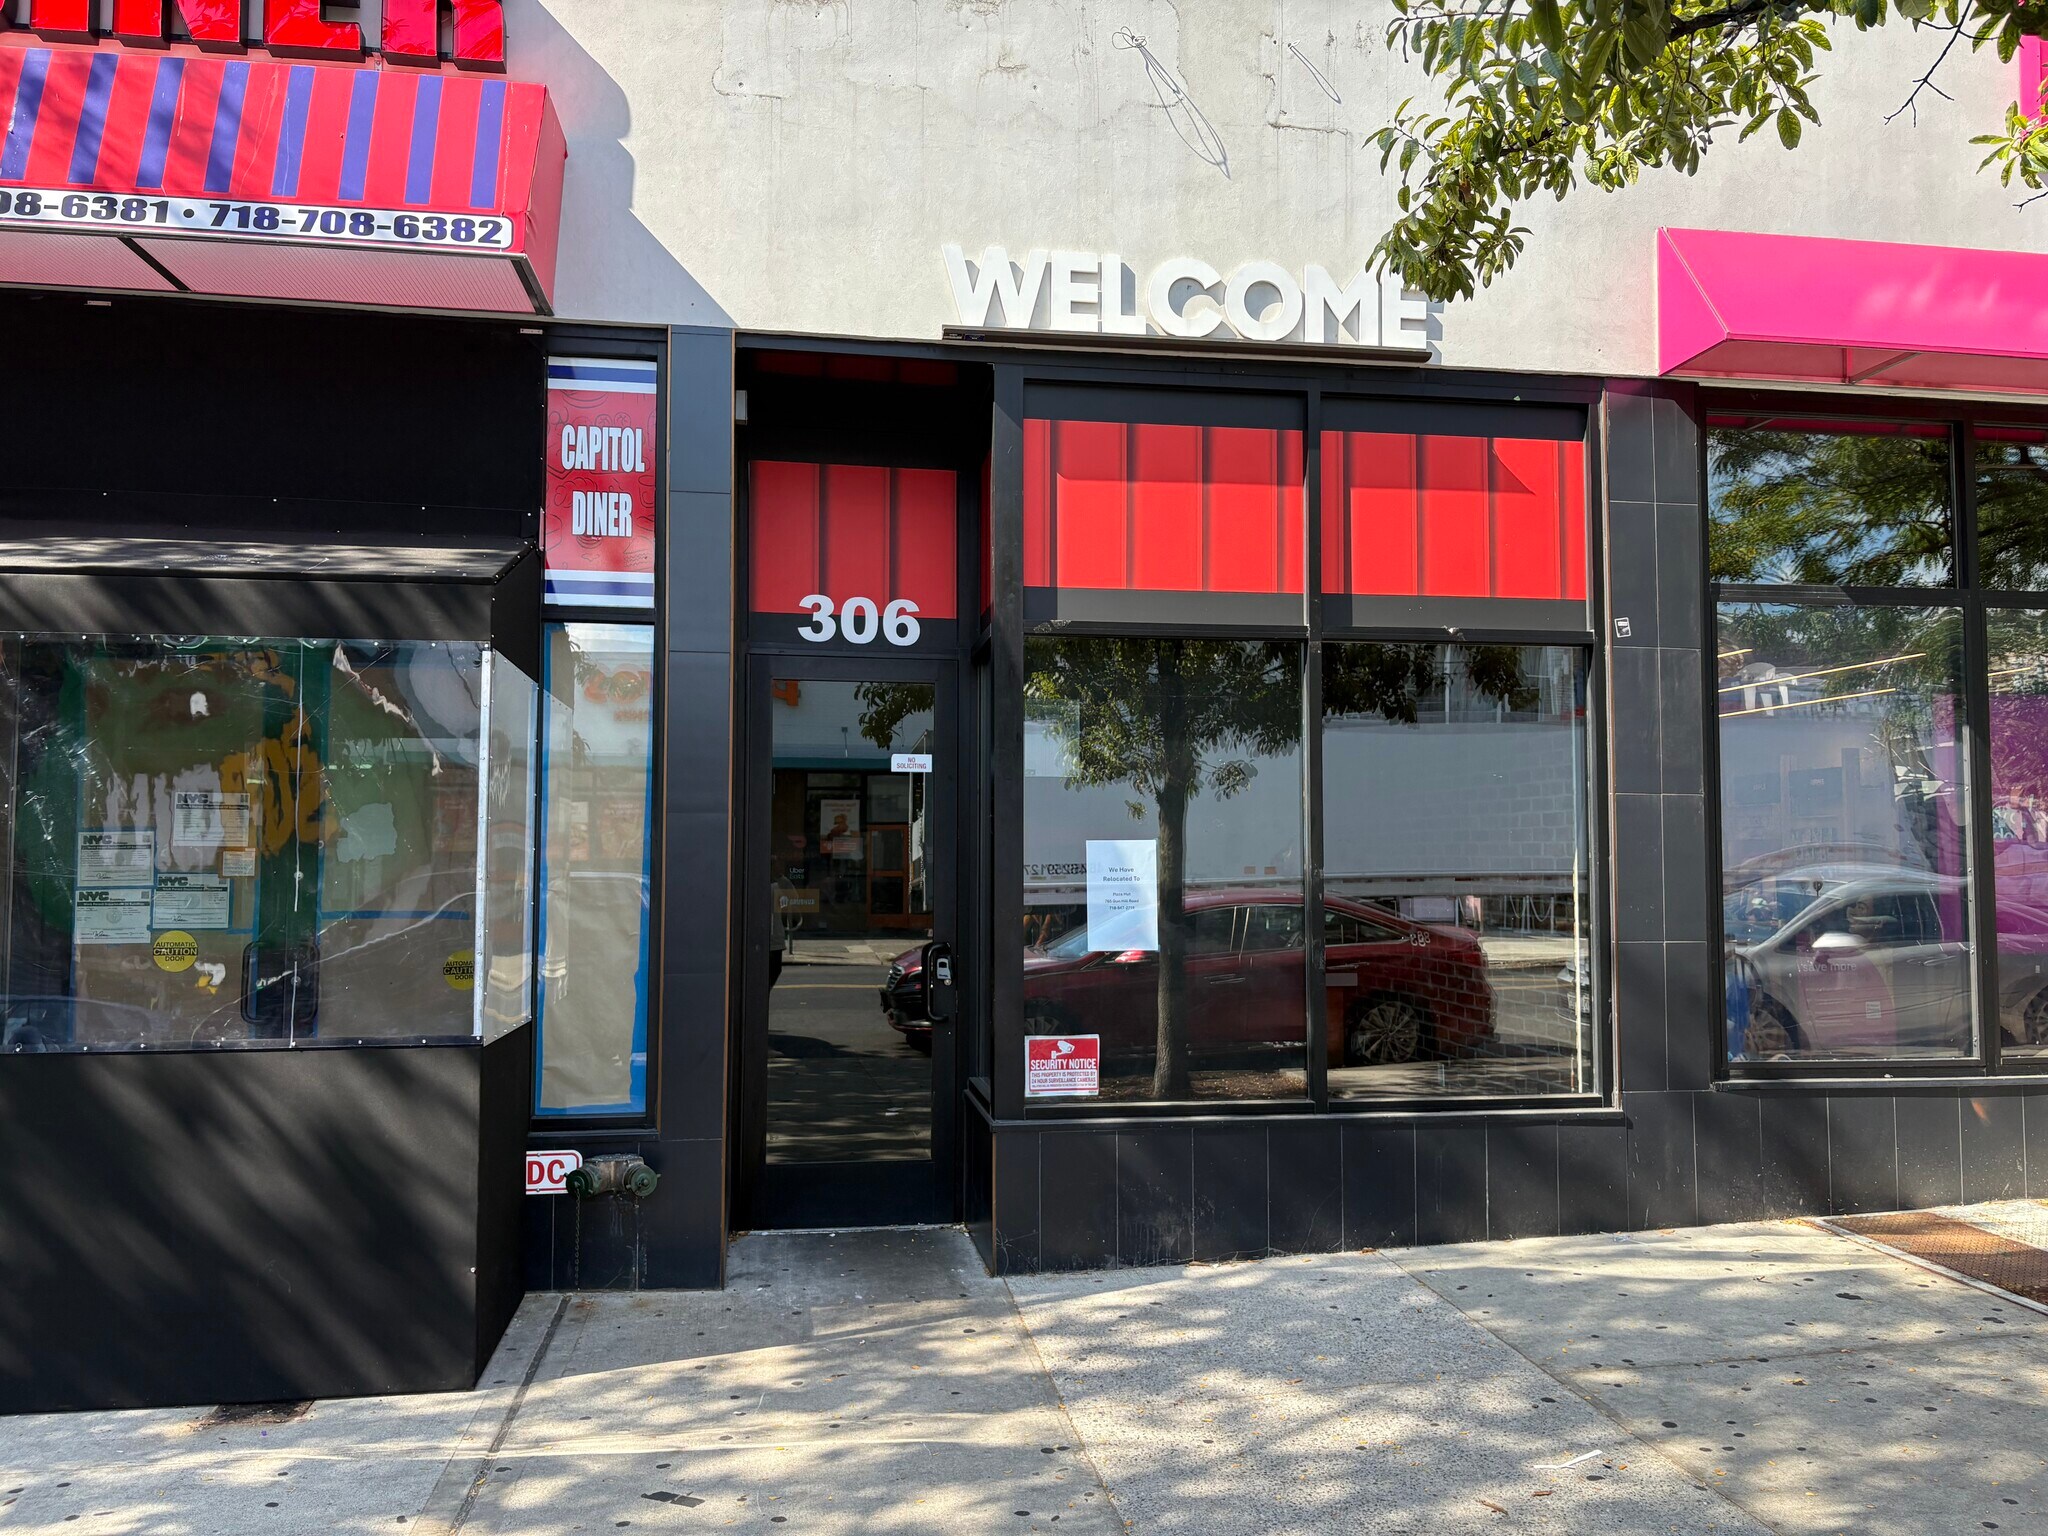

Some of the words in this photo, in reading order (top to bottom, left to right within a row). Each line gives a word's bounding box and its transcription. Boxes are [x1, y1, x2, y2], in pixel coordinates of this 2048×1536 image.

[210, 203, 504, 245] 718-708-6382
[941, 244, 1427, 349] WELCOME
[561, 424, 645, 473] CAPITOL
[572, 490, 633, 537] DINER
[797, 594, 921, 647] 306
[177, 793, 209, 804] NYC
[83, 835, 113, 845] NYC
[158, 876, 188, 886] NYC
[79, 891, 109, 901] NYC
[153, 948, 197, 956] CAUTION
[1802, 963, 1827, 972] save
[1830, 962, 1857, 971] more
[1030, 1059, 1067, 1070] SECURITY
[1068, 1058, 1097, 1069] NOTICE
